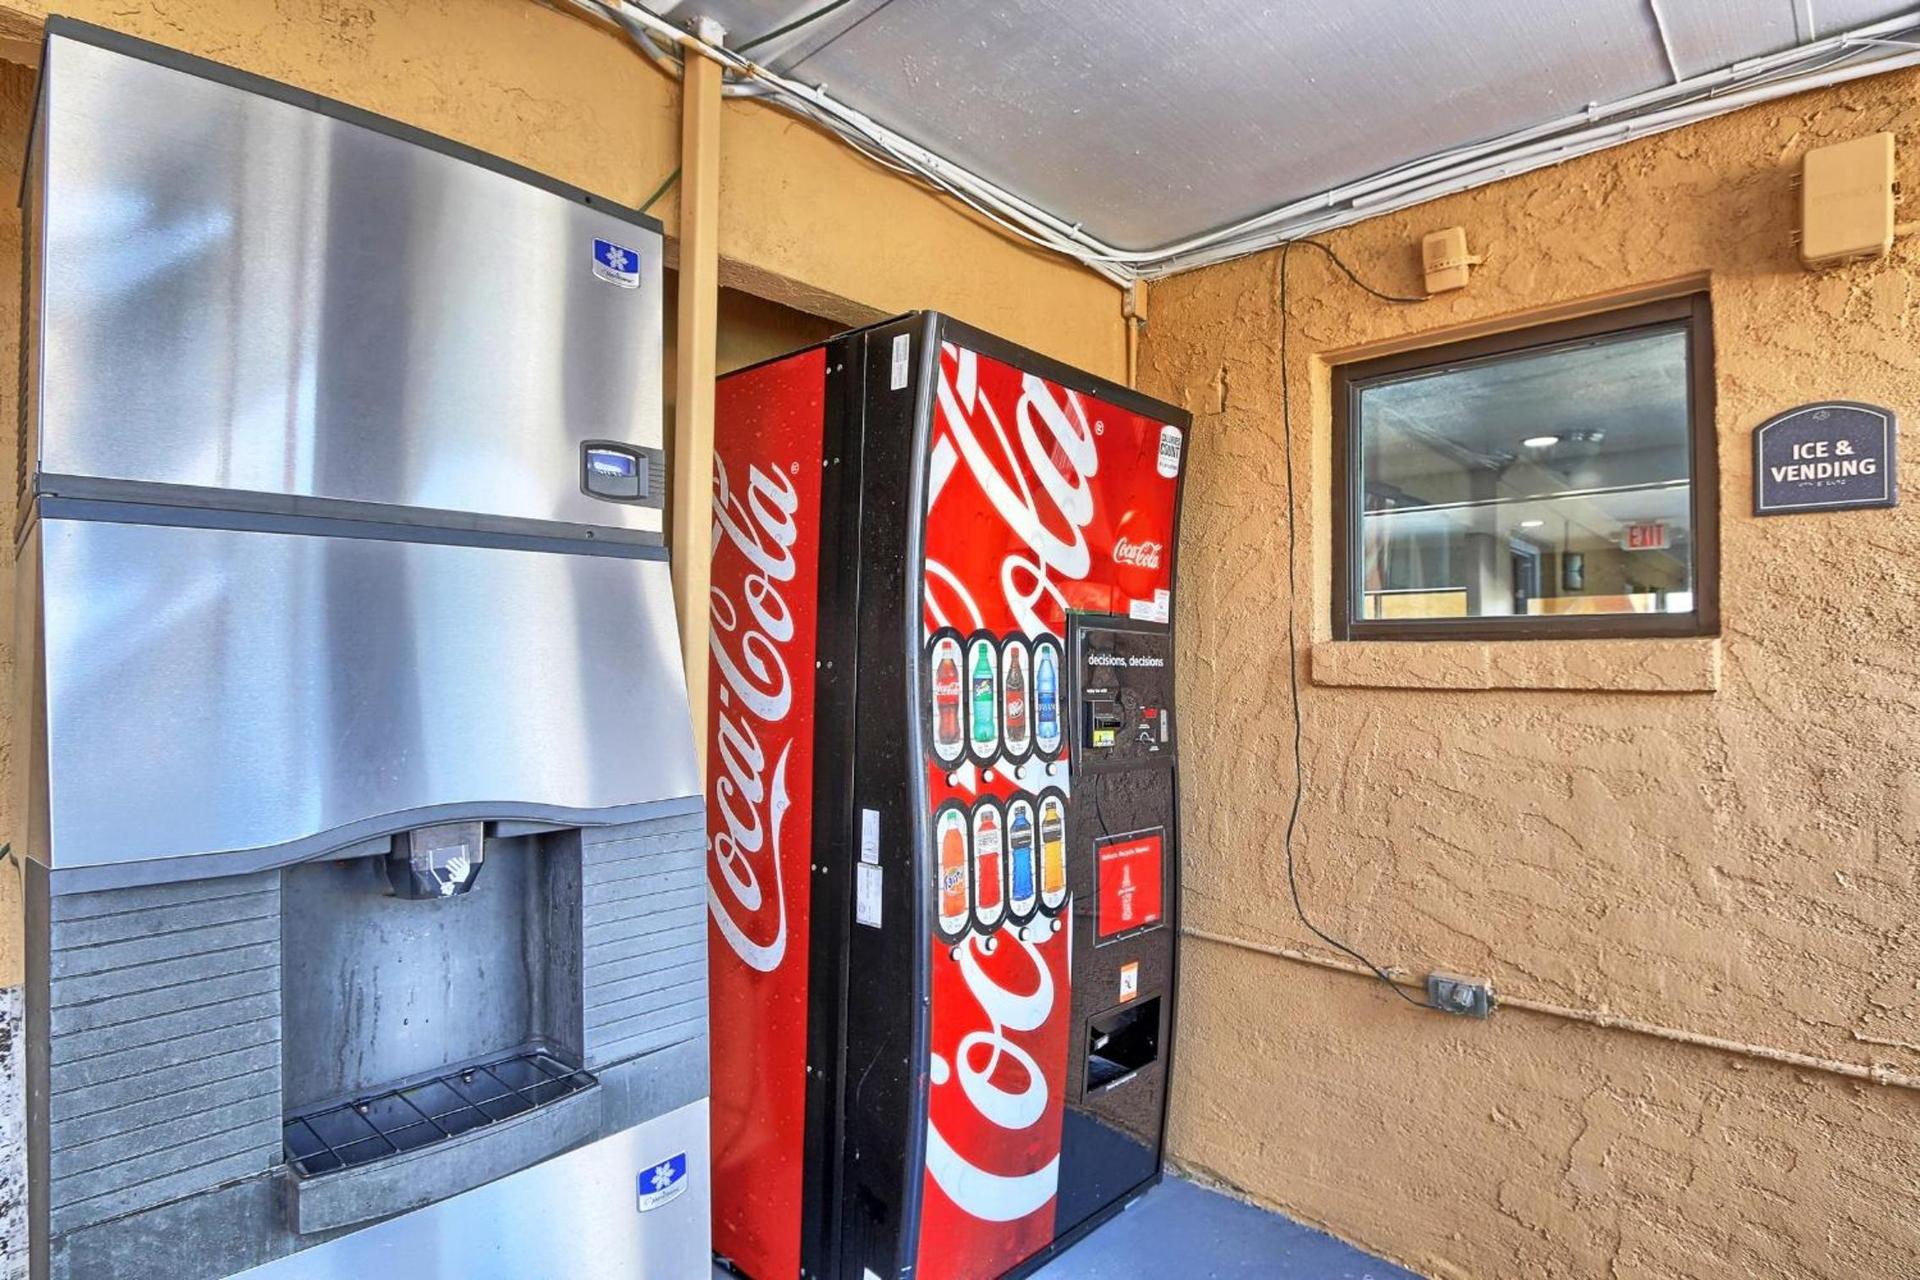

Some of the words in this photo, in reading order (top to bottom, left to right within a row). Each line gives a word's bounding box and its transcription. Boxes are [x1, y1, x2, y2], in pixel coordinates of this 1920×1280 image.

[1793, 441, 1829, 460] ICE
[1835, 440, 1855, 456] &
[1771, 458, 1876, 482] VENDING
[1629, 525, 1664, 548] EXIT
[1113, 536, 1163, 569] Coca-Cola
[1088, 653, 1127, 668] decisions,
[1129, 655, 1164, 667] decisions
